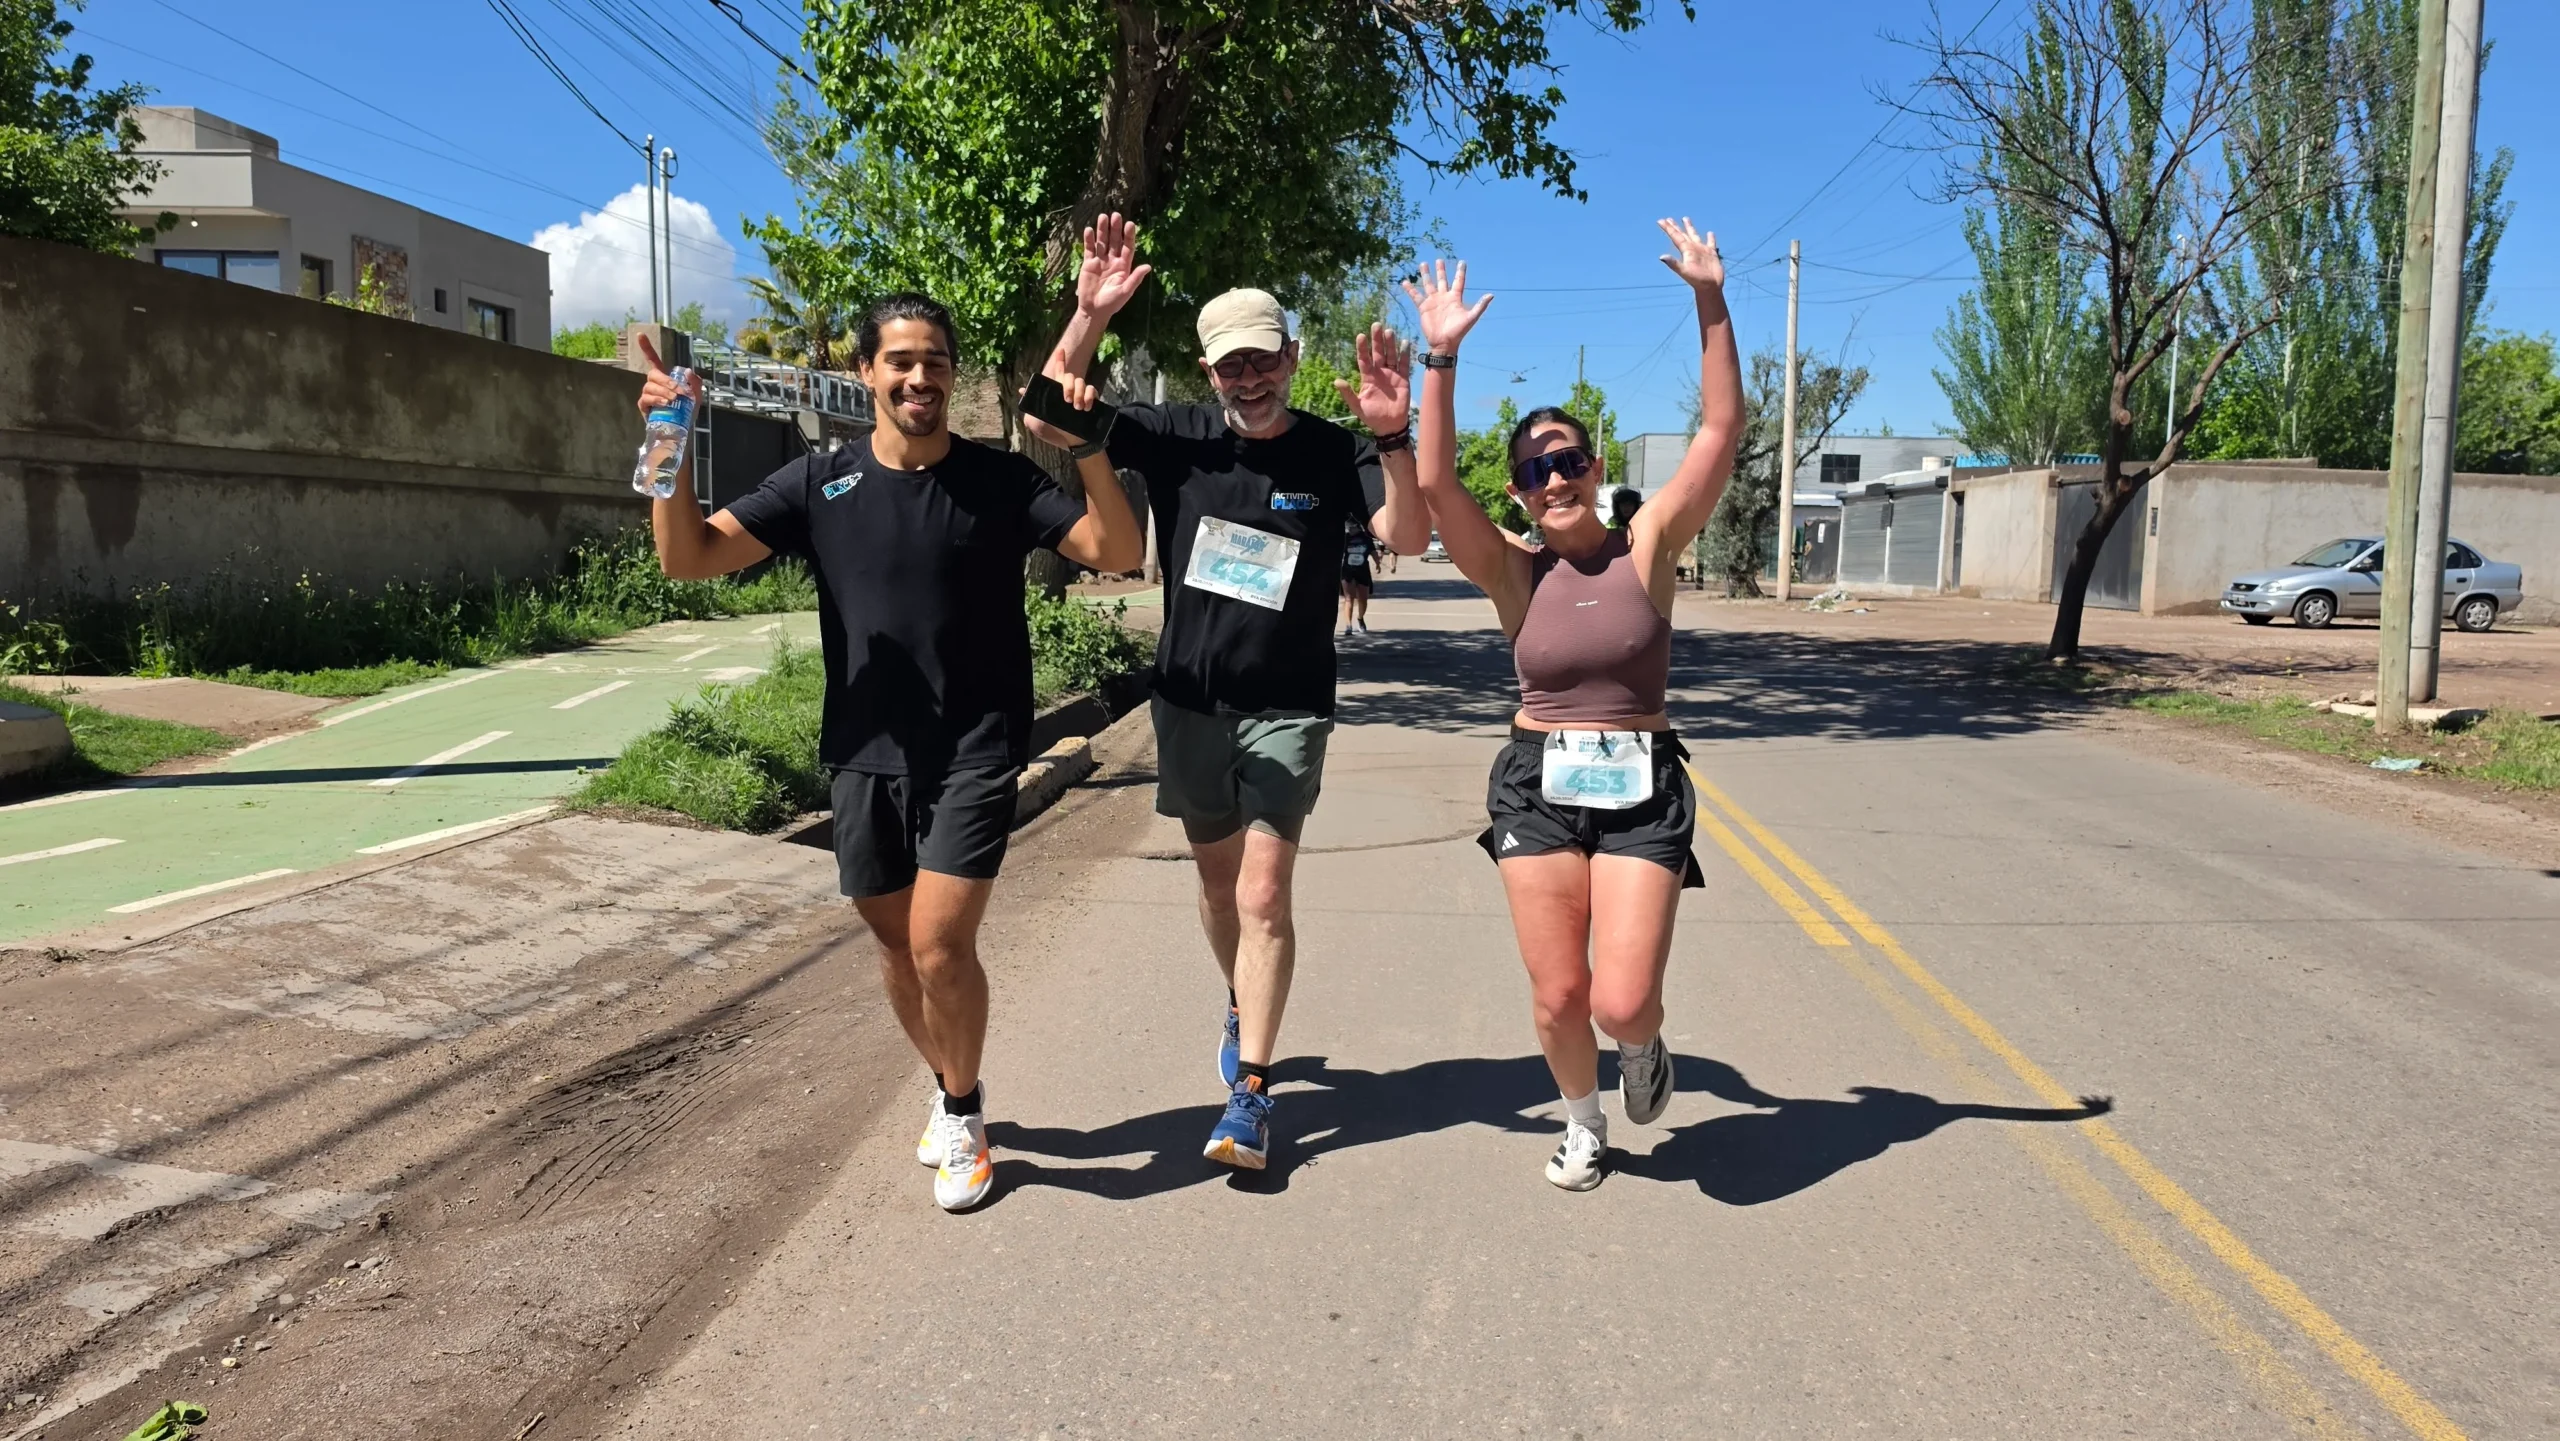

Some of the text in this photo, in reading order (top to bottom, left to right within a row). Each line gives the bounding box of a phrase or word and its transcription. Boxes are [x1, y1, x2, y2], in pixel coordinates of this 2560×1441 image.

[1274, 492, 1310, 500] ACTIVITY
[1274, 499, 1310, 510] PLACE
[1209, 557, 1269, 591] 454
[1565, 768, 1627, 795] 453
